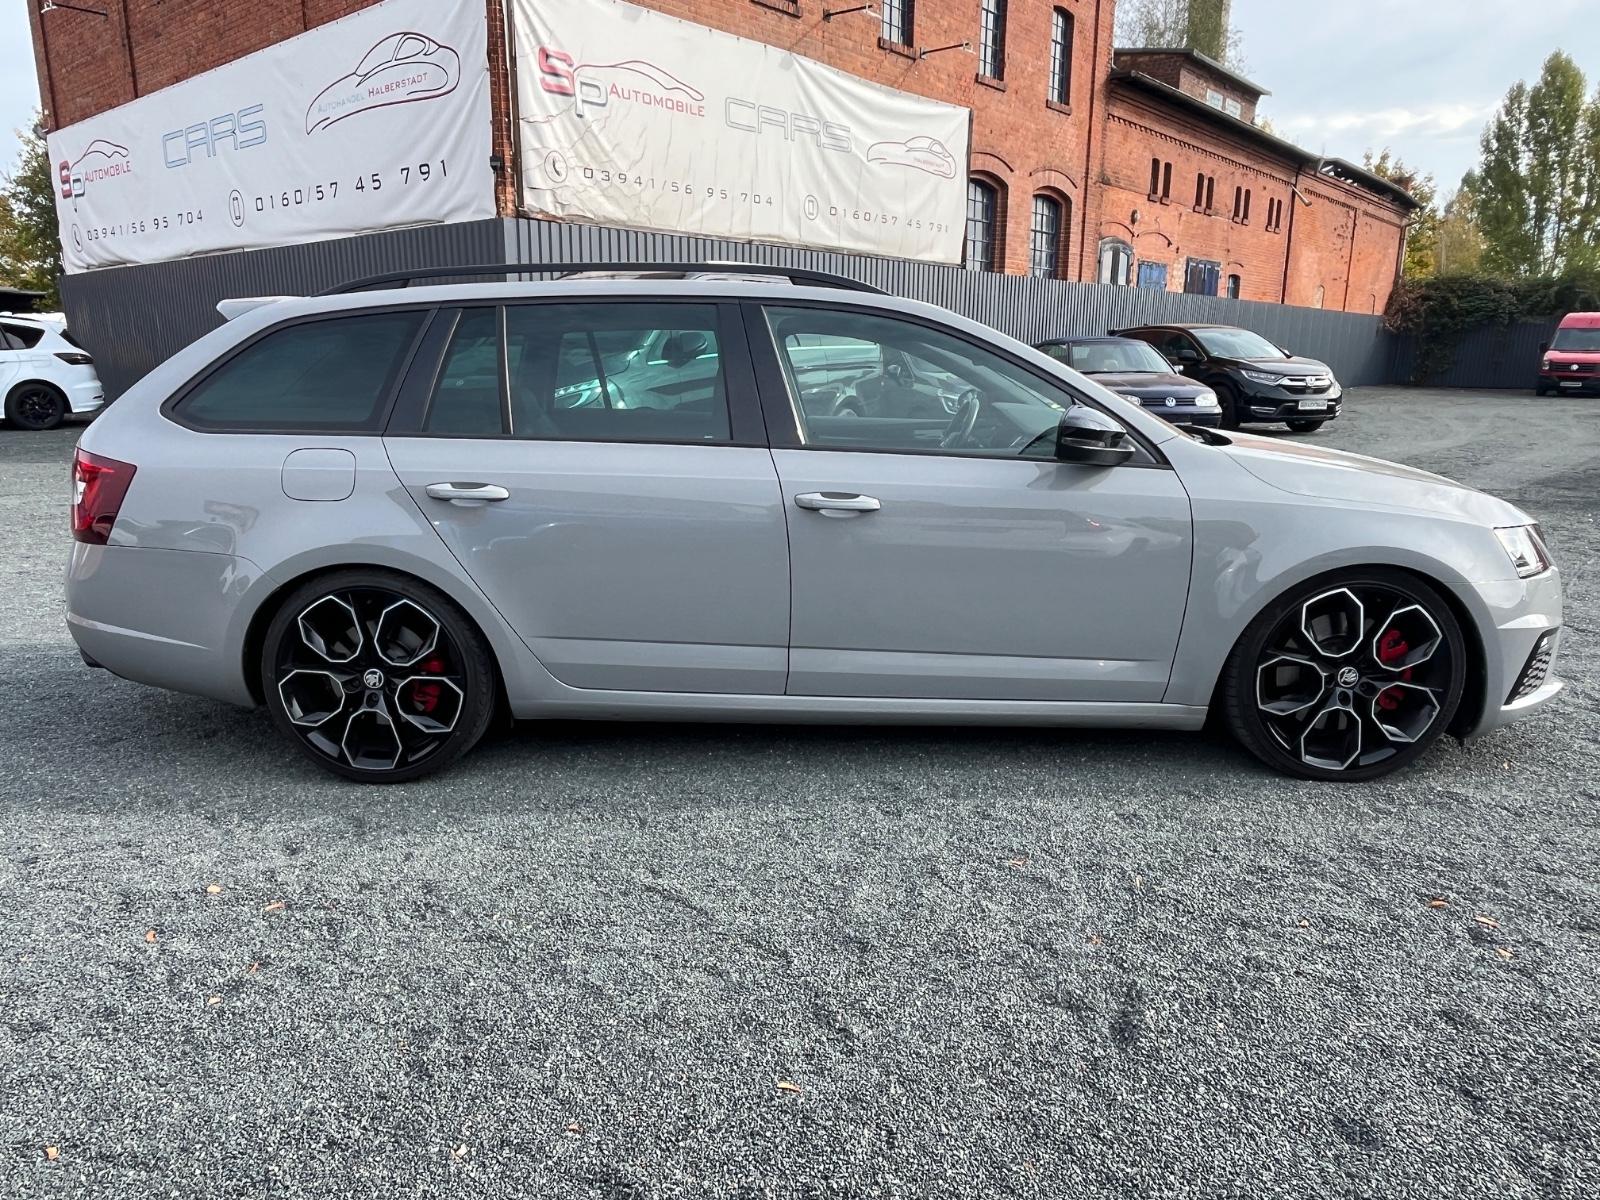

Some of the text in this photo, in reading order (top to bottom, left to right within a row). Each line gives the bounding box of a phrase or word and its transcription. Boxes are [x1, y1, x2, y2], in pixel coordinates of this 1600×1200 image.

[368, 72, 428, 98] HALBERSTADT
[609, 82, 705, 118] AUTOMOBILE
[162, 103, 267, 169] CARS
[725, 96, 852, 153] CARS
[84, 160, 132, 182] AUTOMOBILE
[255, 159, 448, 212] 0160/57 45 791
[583, 167, 773, 207] 03941/56 95 704
[87, 209, 203, 241] 03941/56 95 704
[829, 206, 898, 226] 0160/57
